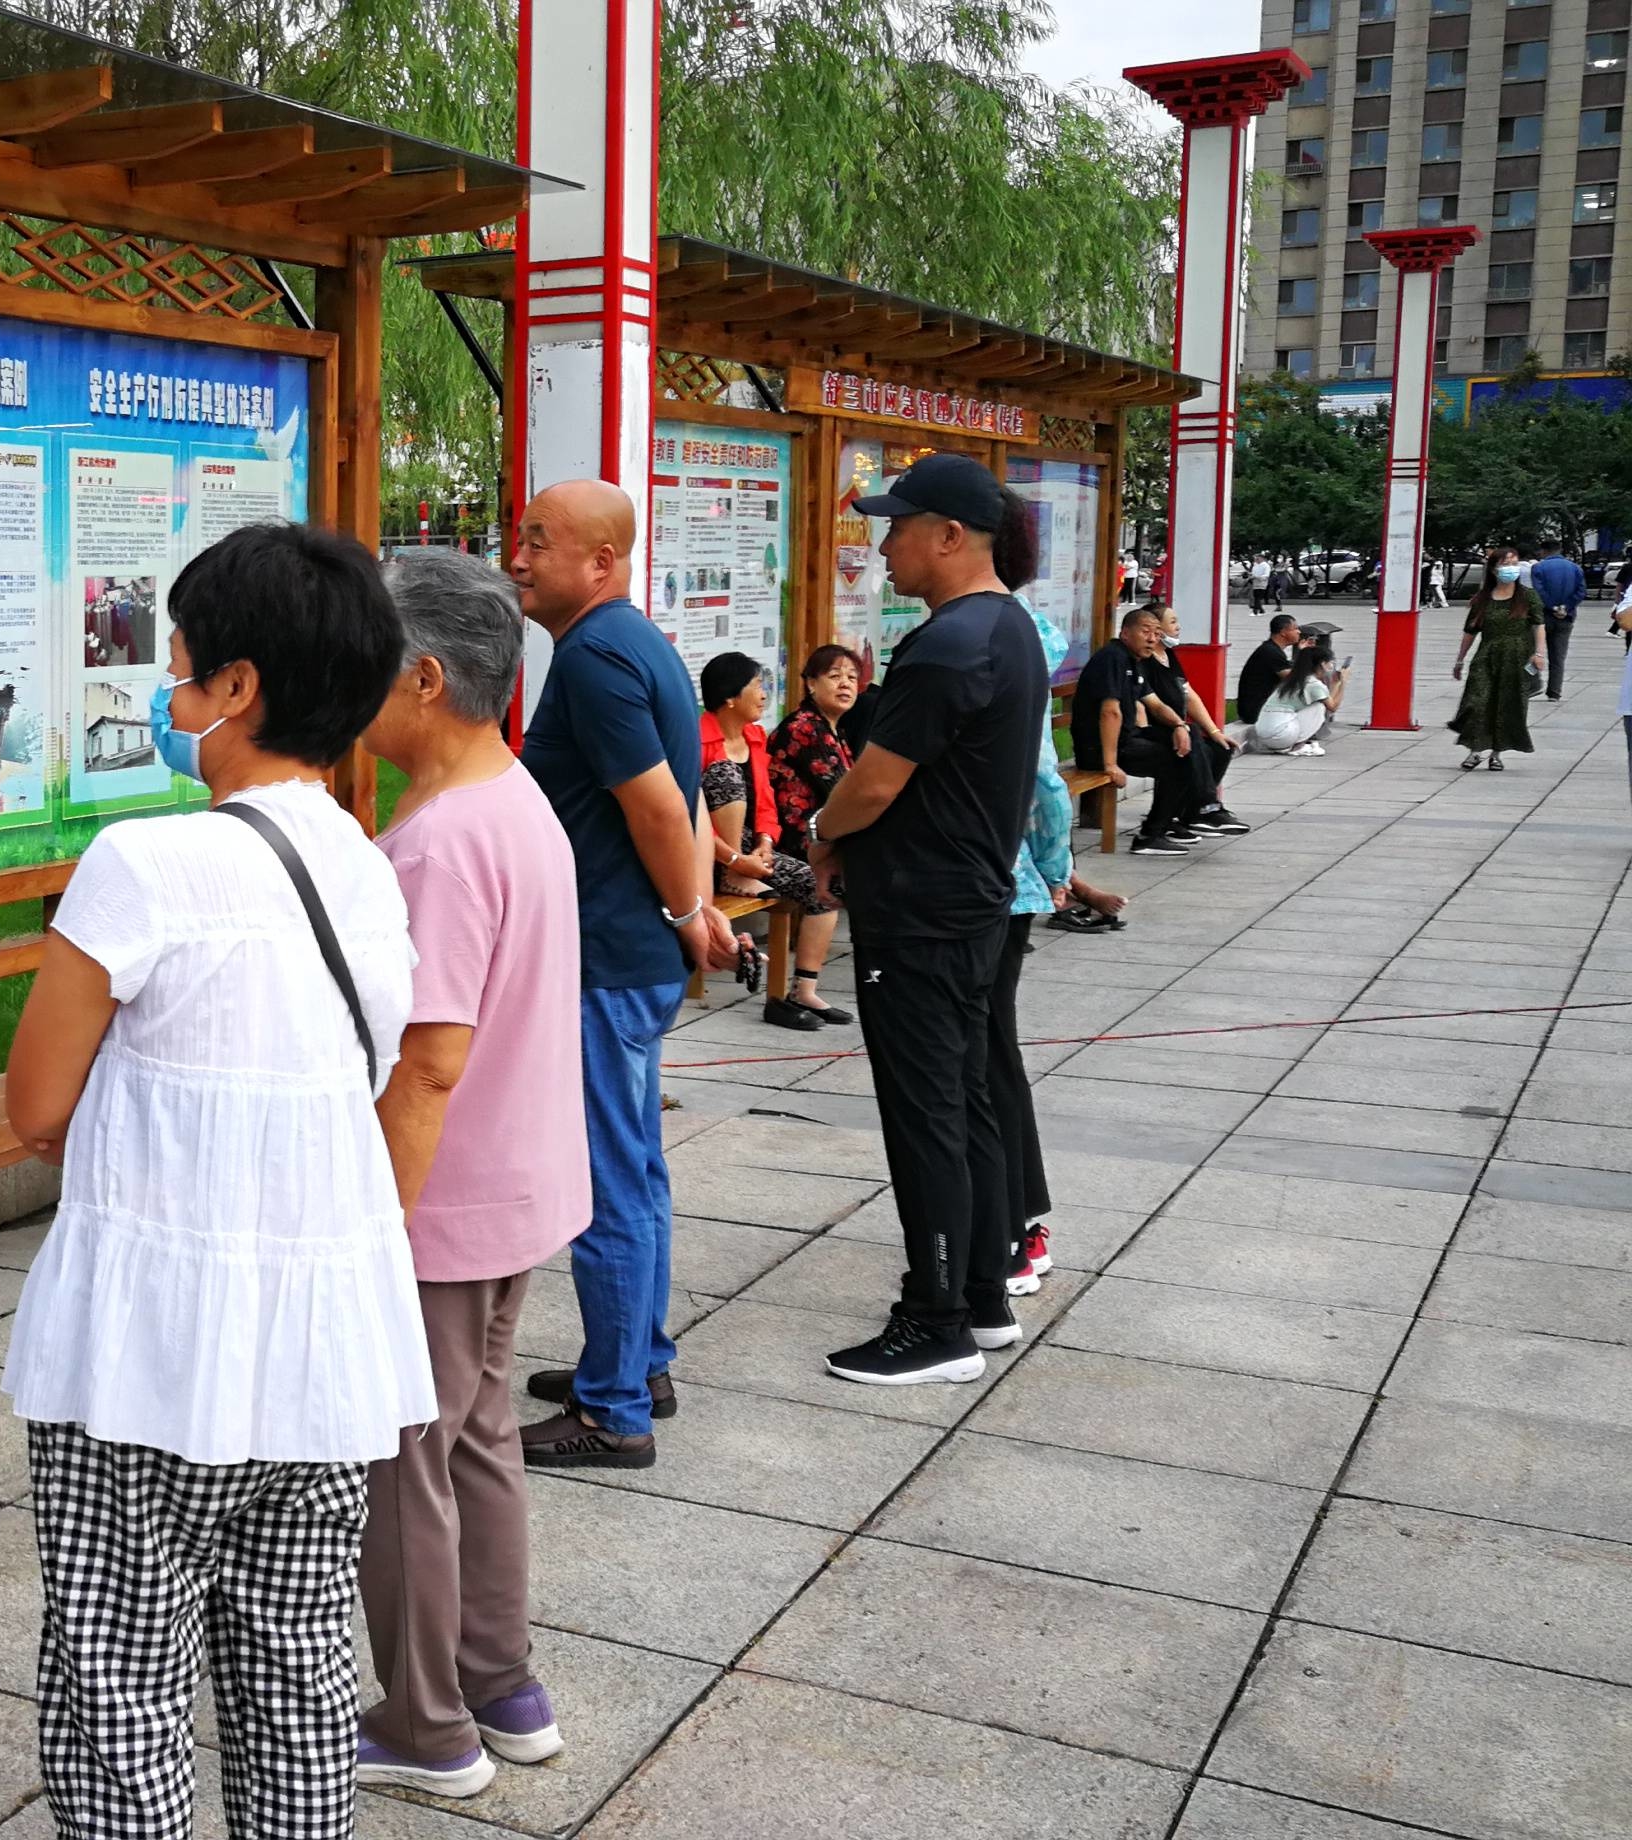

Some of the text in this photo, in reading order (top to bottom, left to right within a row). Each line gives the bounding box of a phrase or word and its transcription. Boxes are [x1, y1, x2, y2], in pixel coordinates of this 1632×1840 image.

[823, 369, 1024, 435] 舒兰市应急管理文化宣传栏
